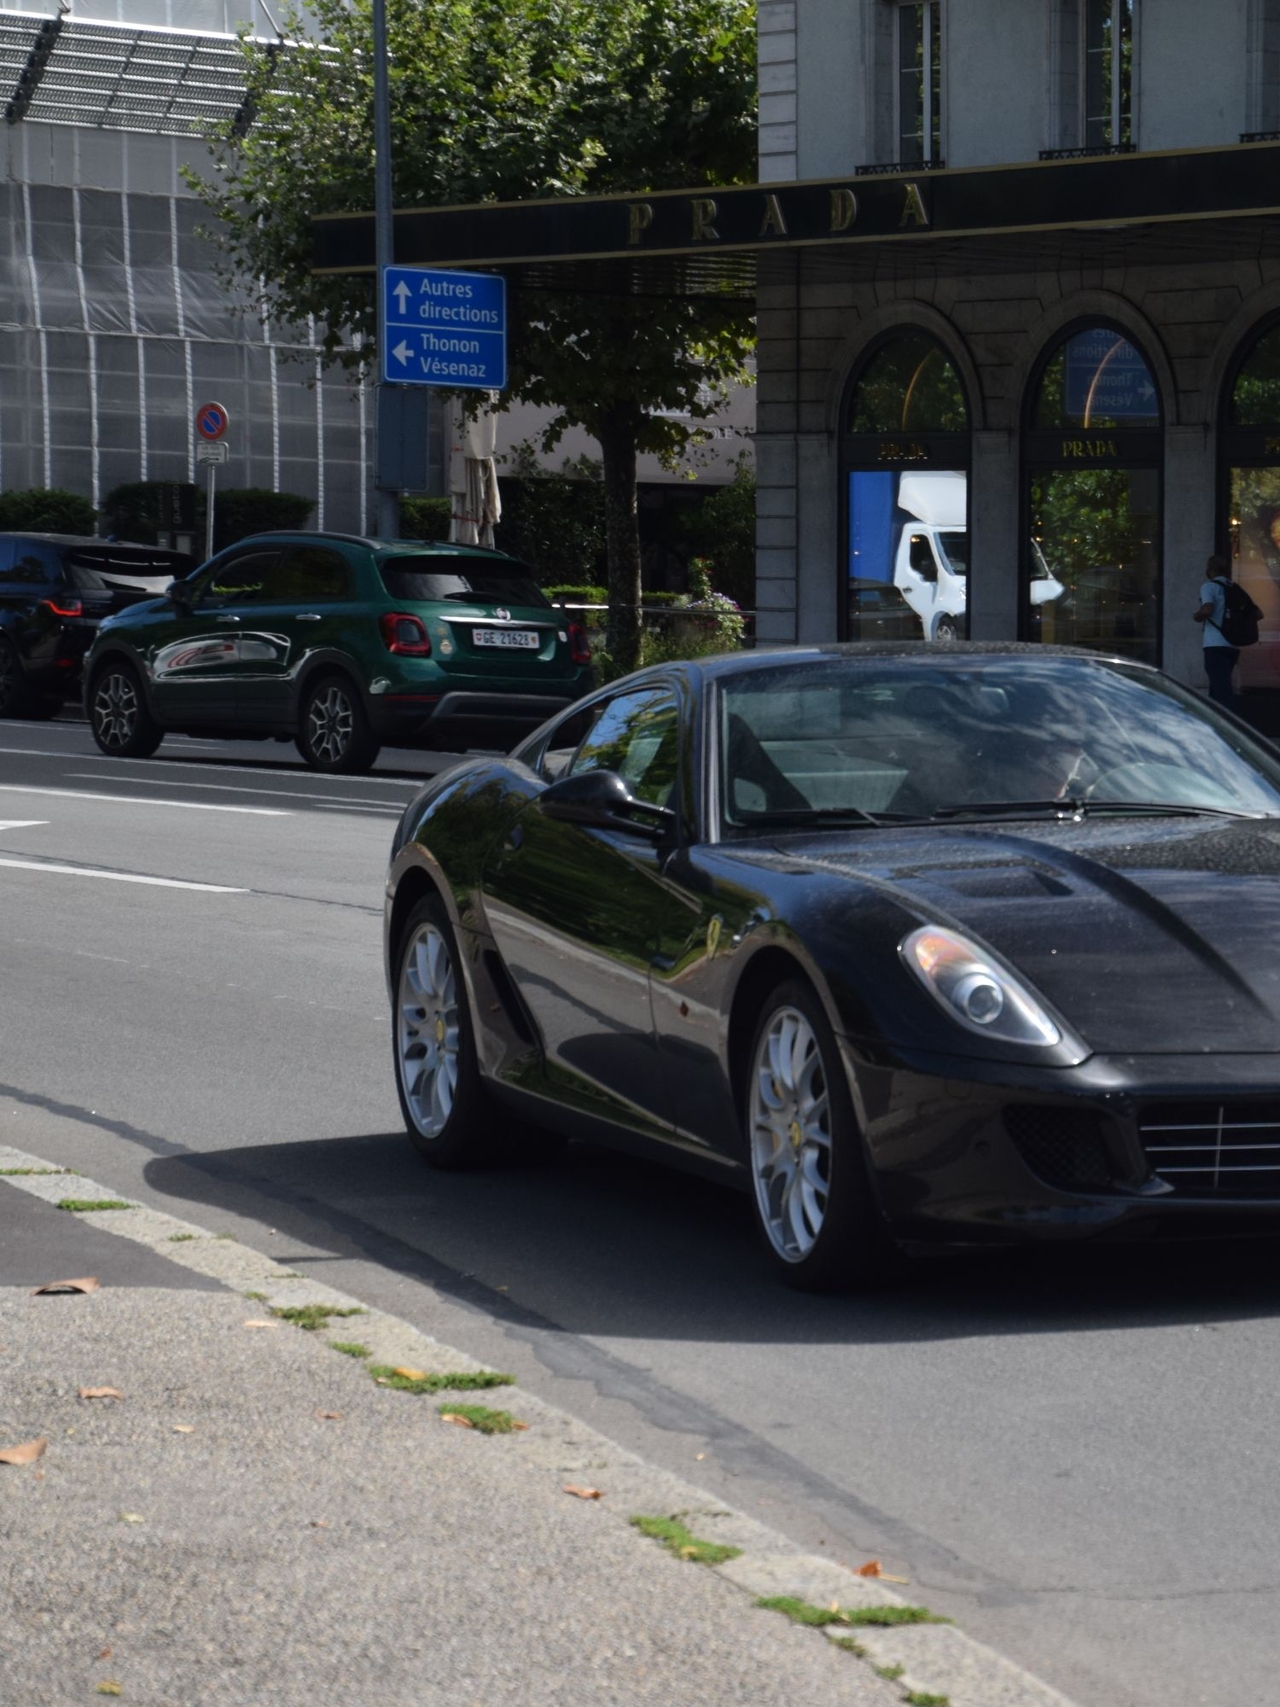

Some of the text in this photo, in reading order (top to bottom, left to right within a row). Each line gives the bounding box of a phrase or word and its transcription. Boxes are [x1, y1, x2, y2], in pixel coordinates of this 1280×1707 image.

[626, 183, 929, 245] PRADA
[420, 278, 473, 298] Autres
[419, 300, 499, 323] directions
[420, 333, 480, 354] Thonon
[420, 356, 487, 377] Vésenaz
[1062, 440, 1119, 458] PRADA
